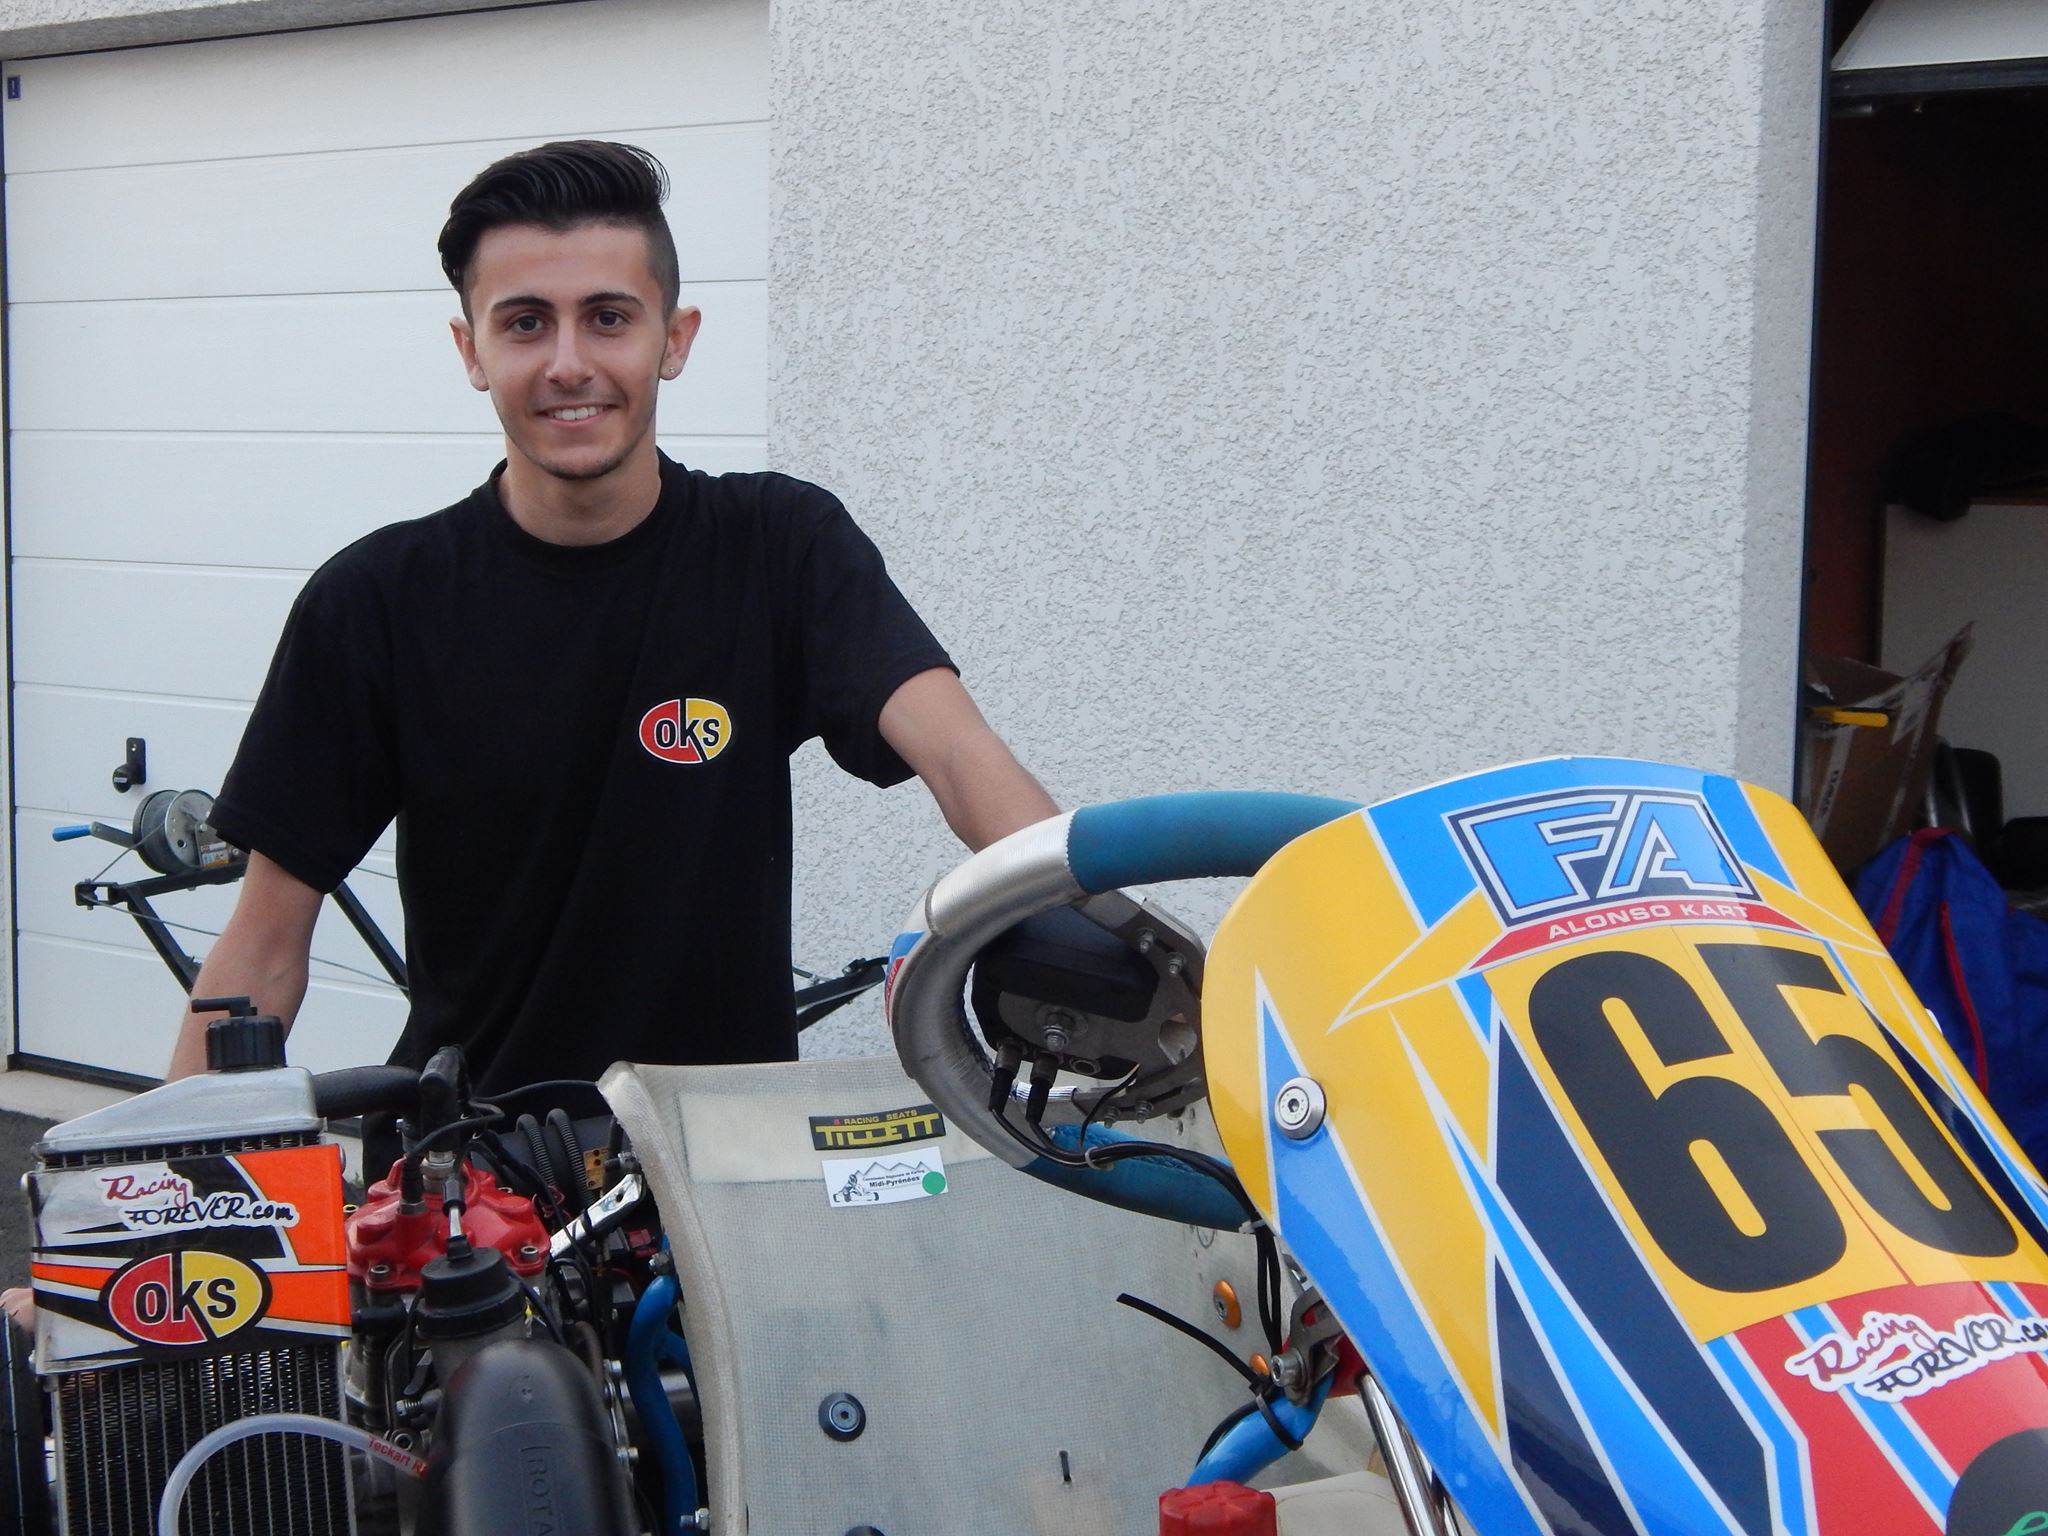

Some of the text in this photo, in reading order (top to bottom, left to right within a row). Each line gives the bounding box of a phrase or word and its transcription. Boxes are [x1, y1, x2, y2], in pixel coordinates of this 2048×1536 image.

[1458, 794, 1753, 919] FA
[1549, 900, 1749, 940] ALONSO KART
[815, 1112, 940, 1147] TILLETT
[843, 1109, 918, 1126] RACING SEATS
[1529, 943, 2018, 1293] 65
[101, 1172, 188, 1208] Racing
[1794, 1315, 1940, 1382] Racing
[1863, 1317, 2048, 1393] FOREVER.co
